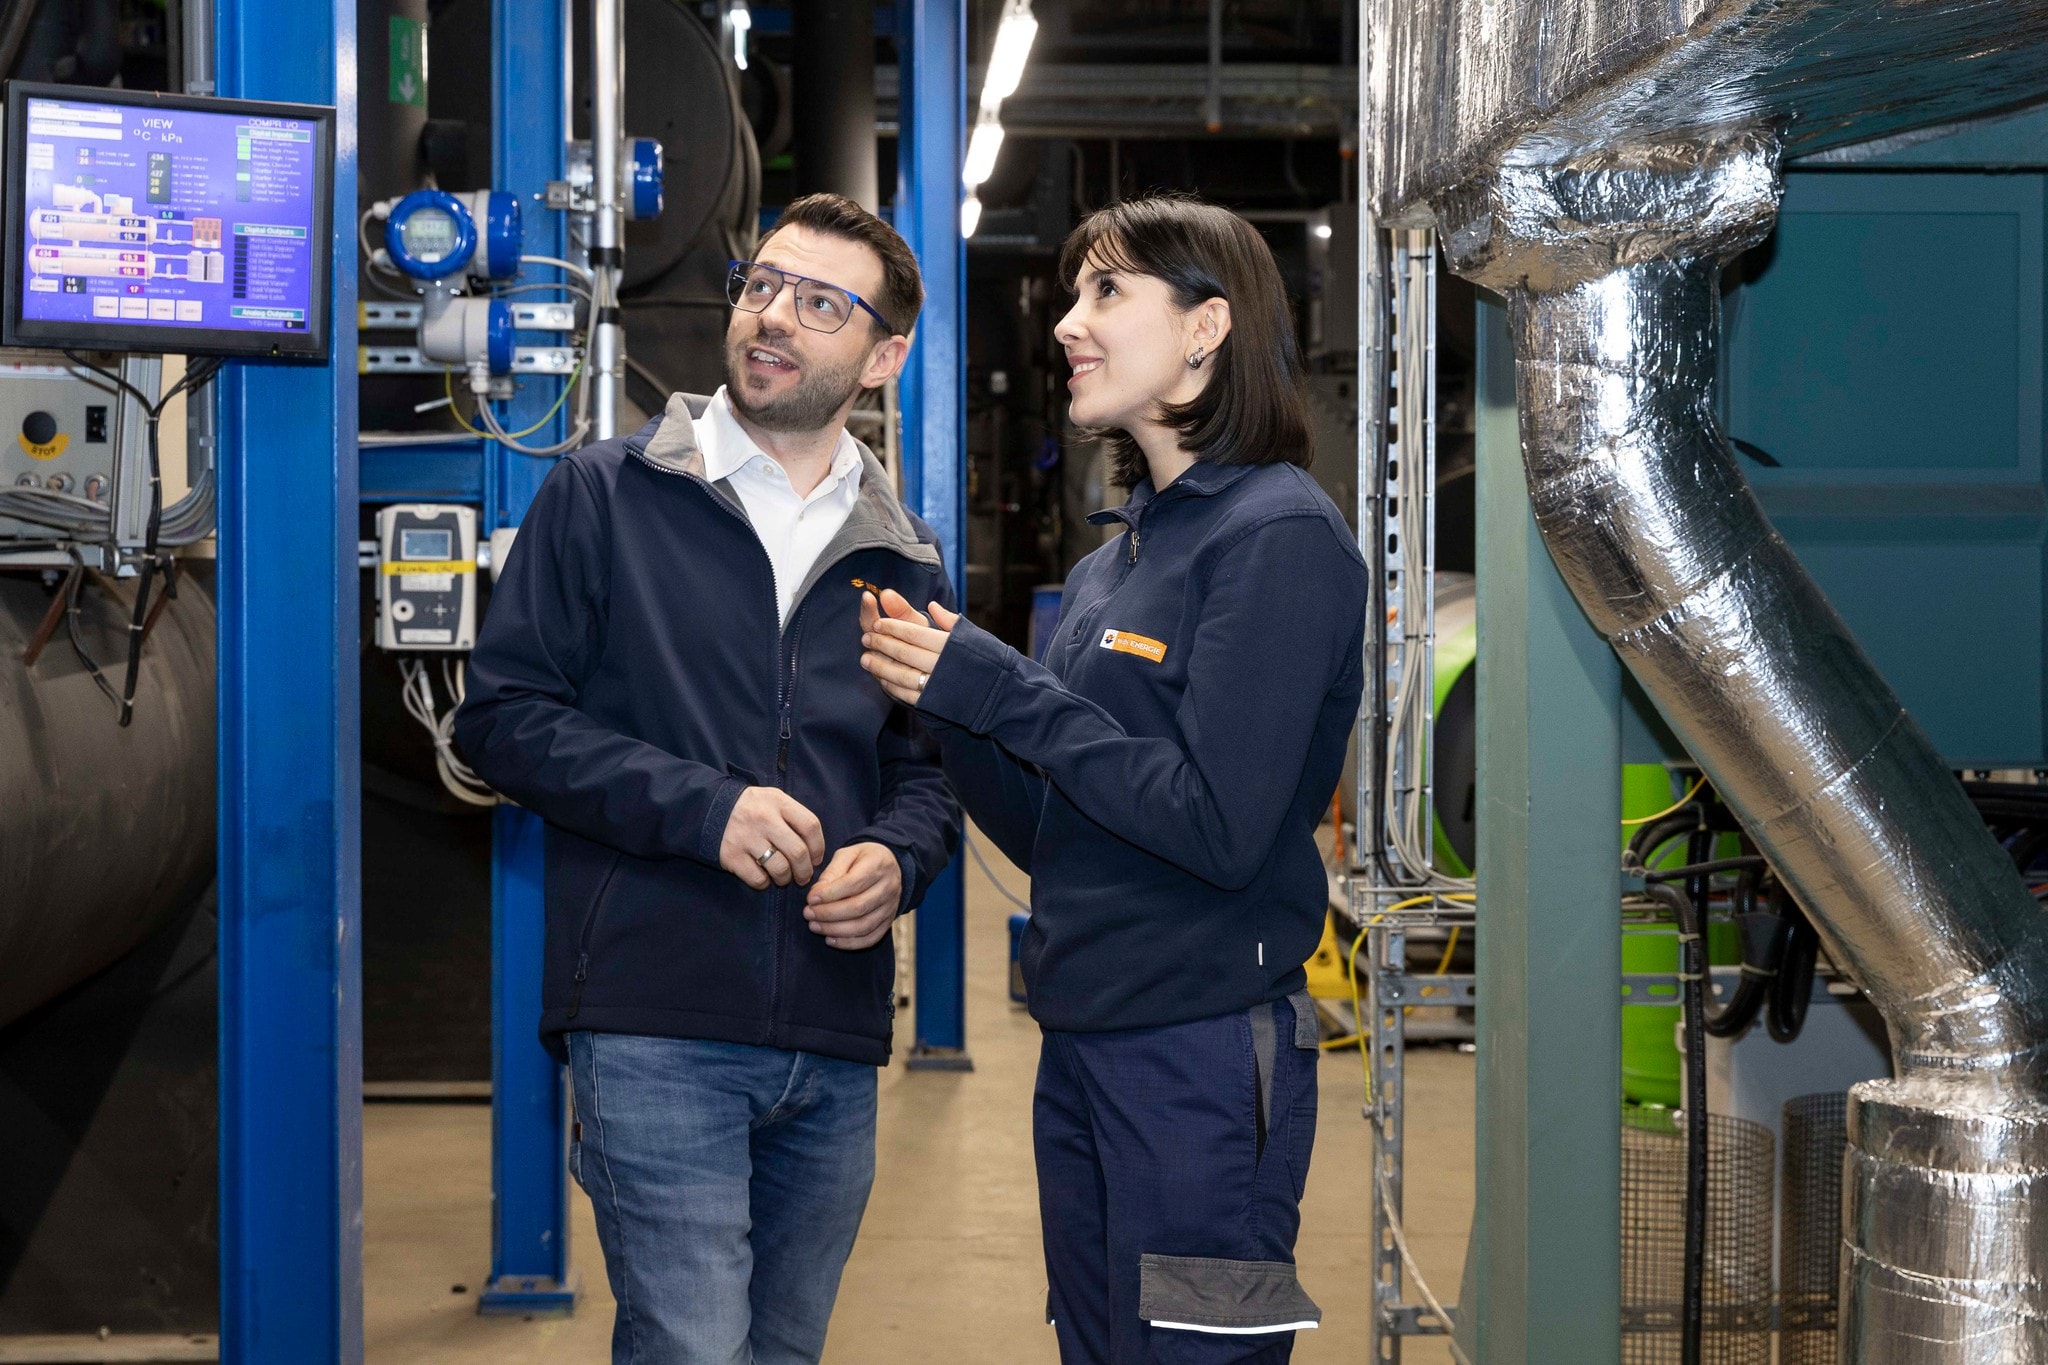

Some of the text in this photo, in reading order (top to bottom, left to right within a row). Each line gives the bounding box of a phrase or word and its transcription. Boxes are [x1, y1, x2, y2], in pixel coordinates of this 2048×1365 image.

[142, 118, 173, 129] VIEW
[161, 133, 183, 144] kPa
[31, 446, 56, 456] STOP
[1130, 640, 1161, 656] ENERGIE
